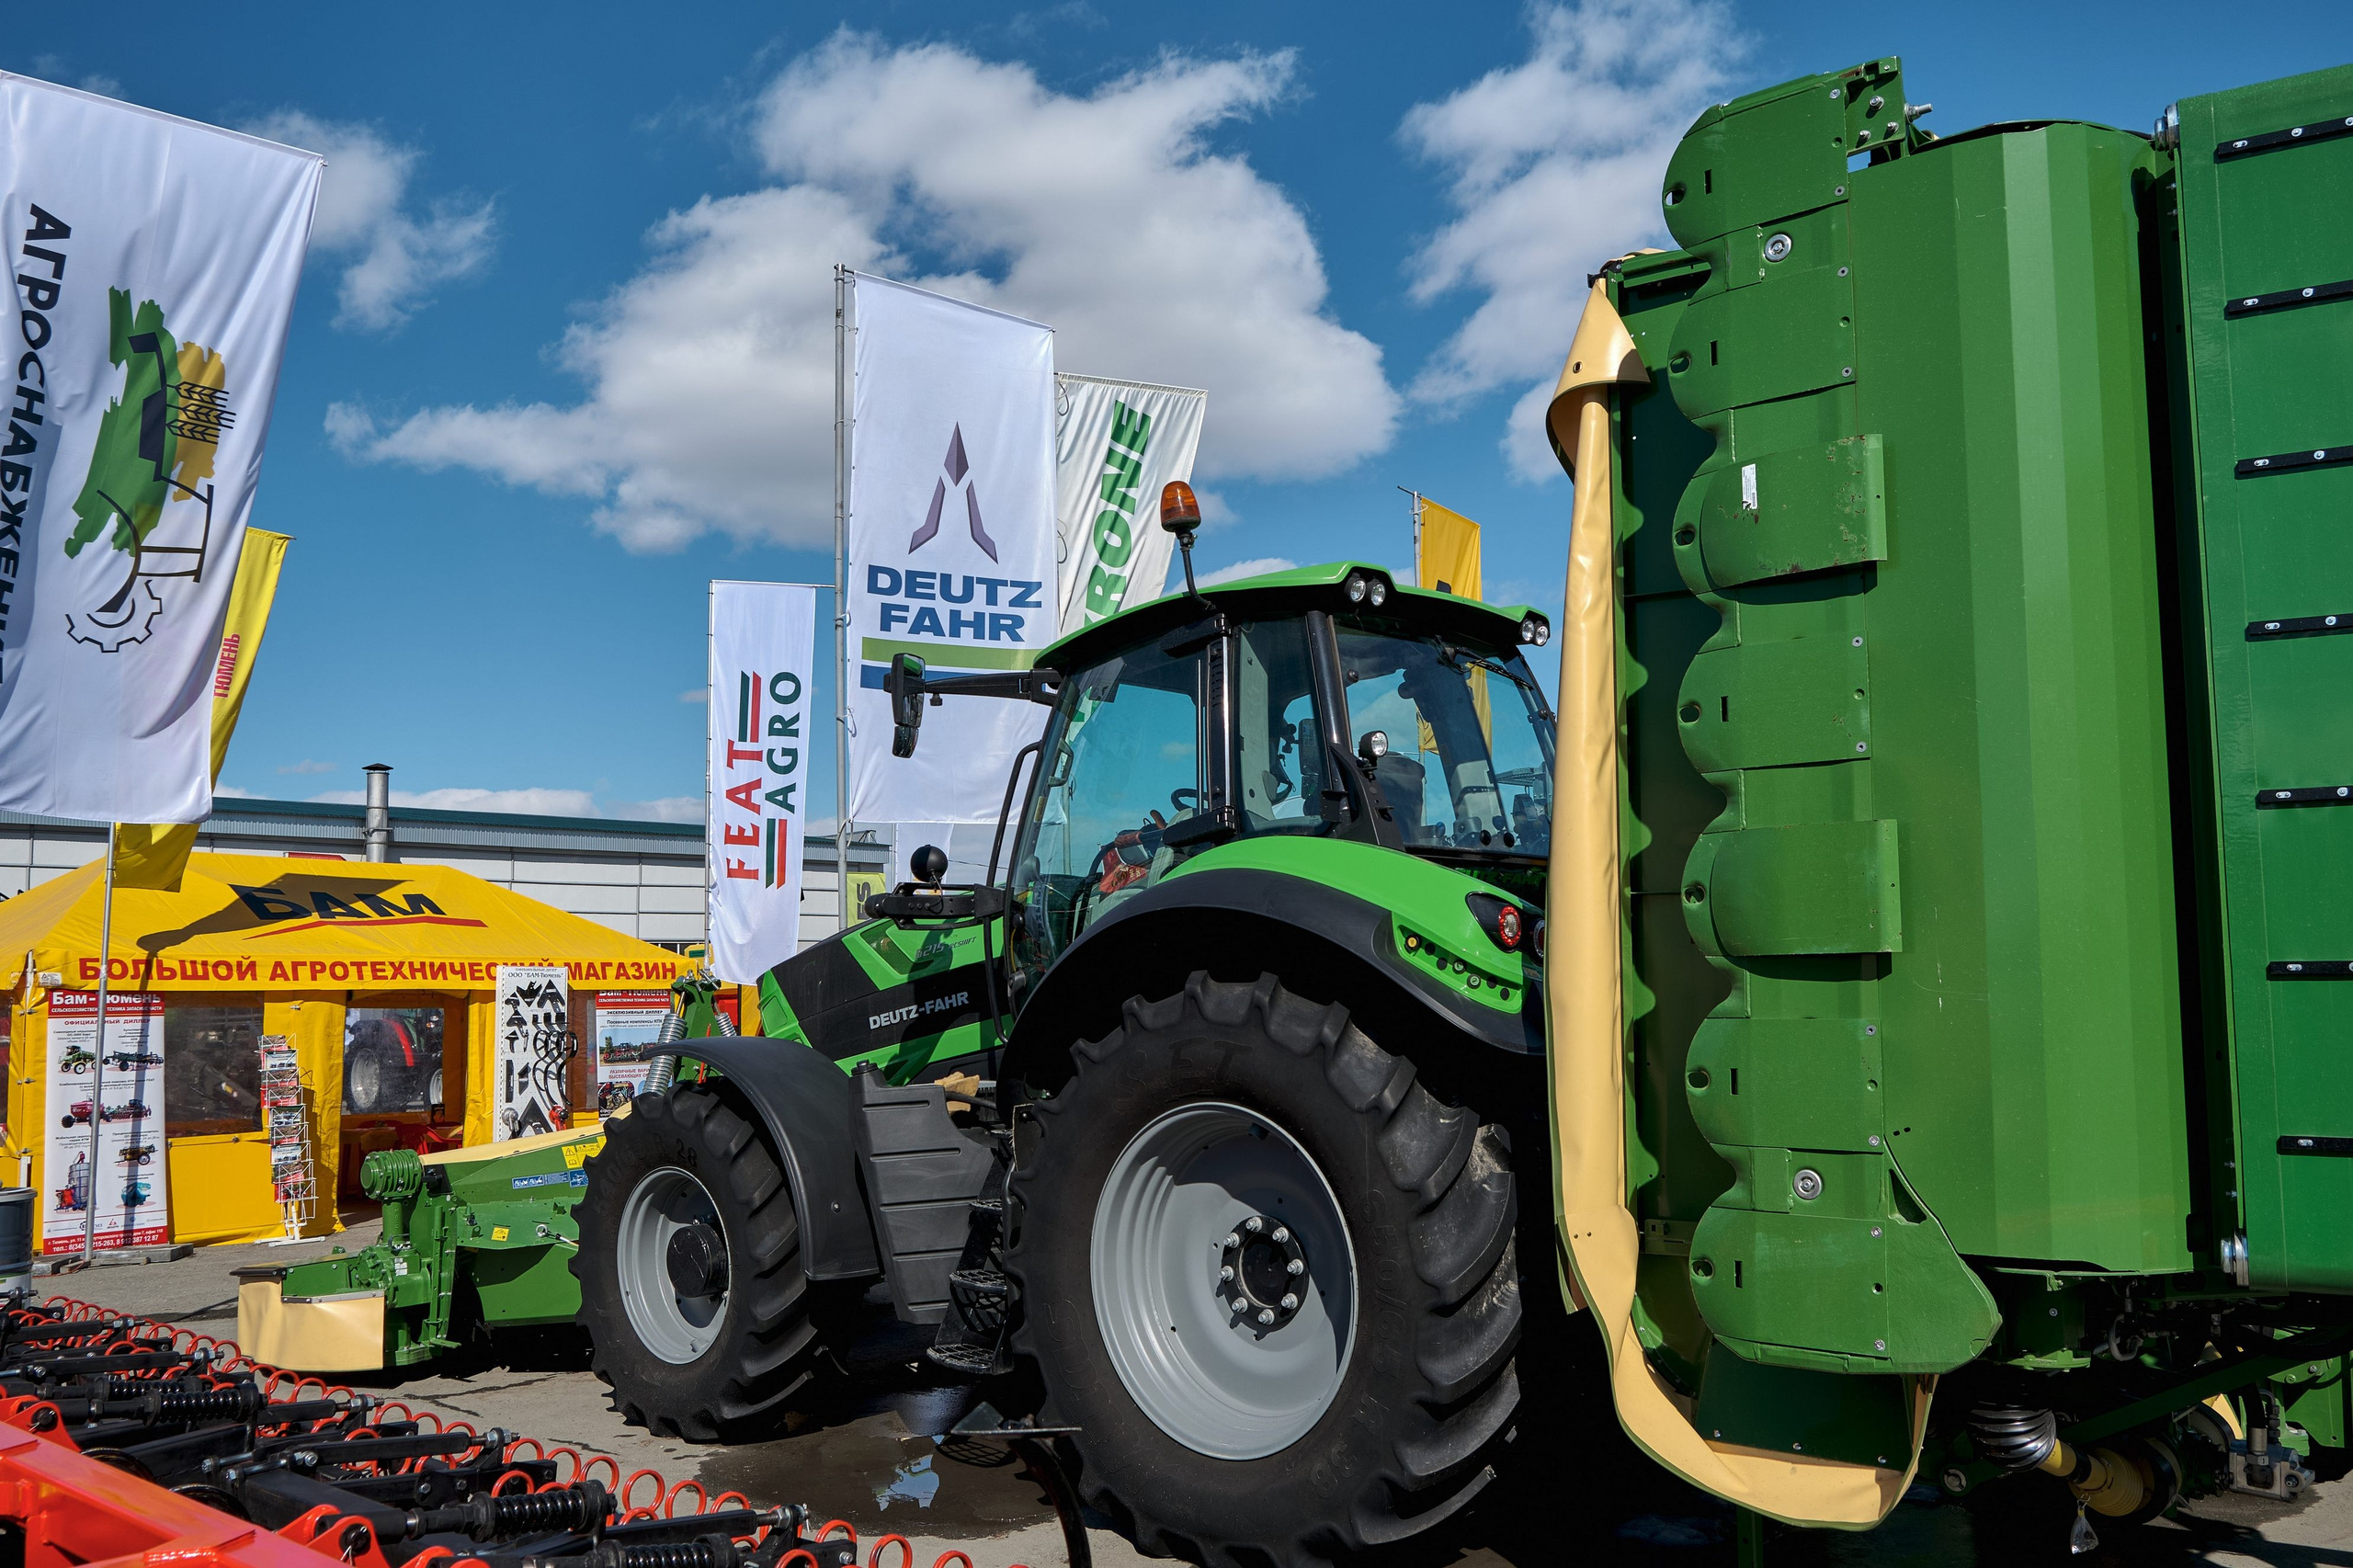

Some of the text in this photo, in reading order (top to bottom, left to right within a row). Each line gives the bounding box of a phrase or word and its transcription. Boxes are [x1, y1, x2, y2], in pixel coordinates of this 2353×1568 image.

[867, 564, 1042, 608] DEUTZ
[879, 602, 1027, 642] FAHR
[765, 671, 802, 814] AGRO
[724, 738, 763, 881] FEAT
[227, 883, 448, 921] БАМ
[79, 956, 258, 981] БОЛЬШОЙ
[563, 961, 676, 981] МАГАЗИН
[52, 992, 161, 1006] Бам-юмень
[869, 991, 970, 1030] DEUTZ-FAHR
[69, 1242, 85, 1251] 8(345
